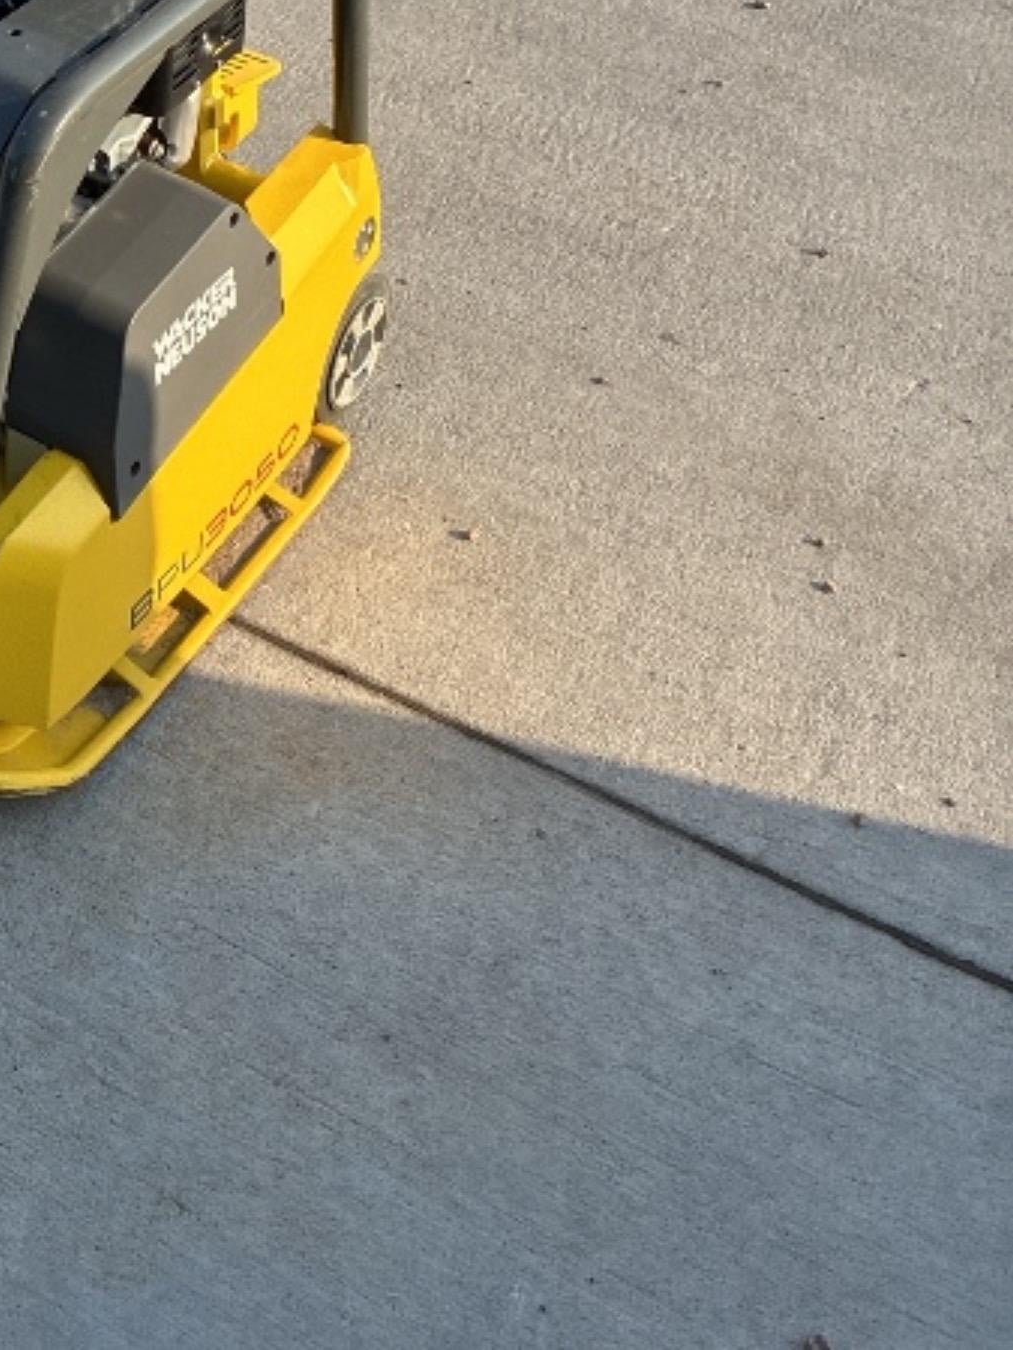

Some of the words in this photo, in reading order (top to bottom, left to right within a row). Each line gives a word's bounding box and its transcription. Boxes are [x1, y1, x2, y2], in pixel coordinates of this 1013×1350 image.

[152, 266, 235, 362] WACKER
[154, 282, 237, 386] NEUSON
[131, 423, 300, 631] BPU3050
